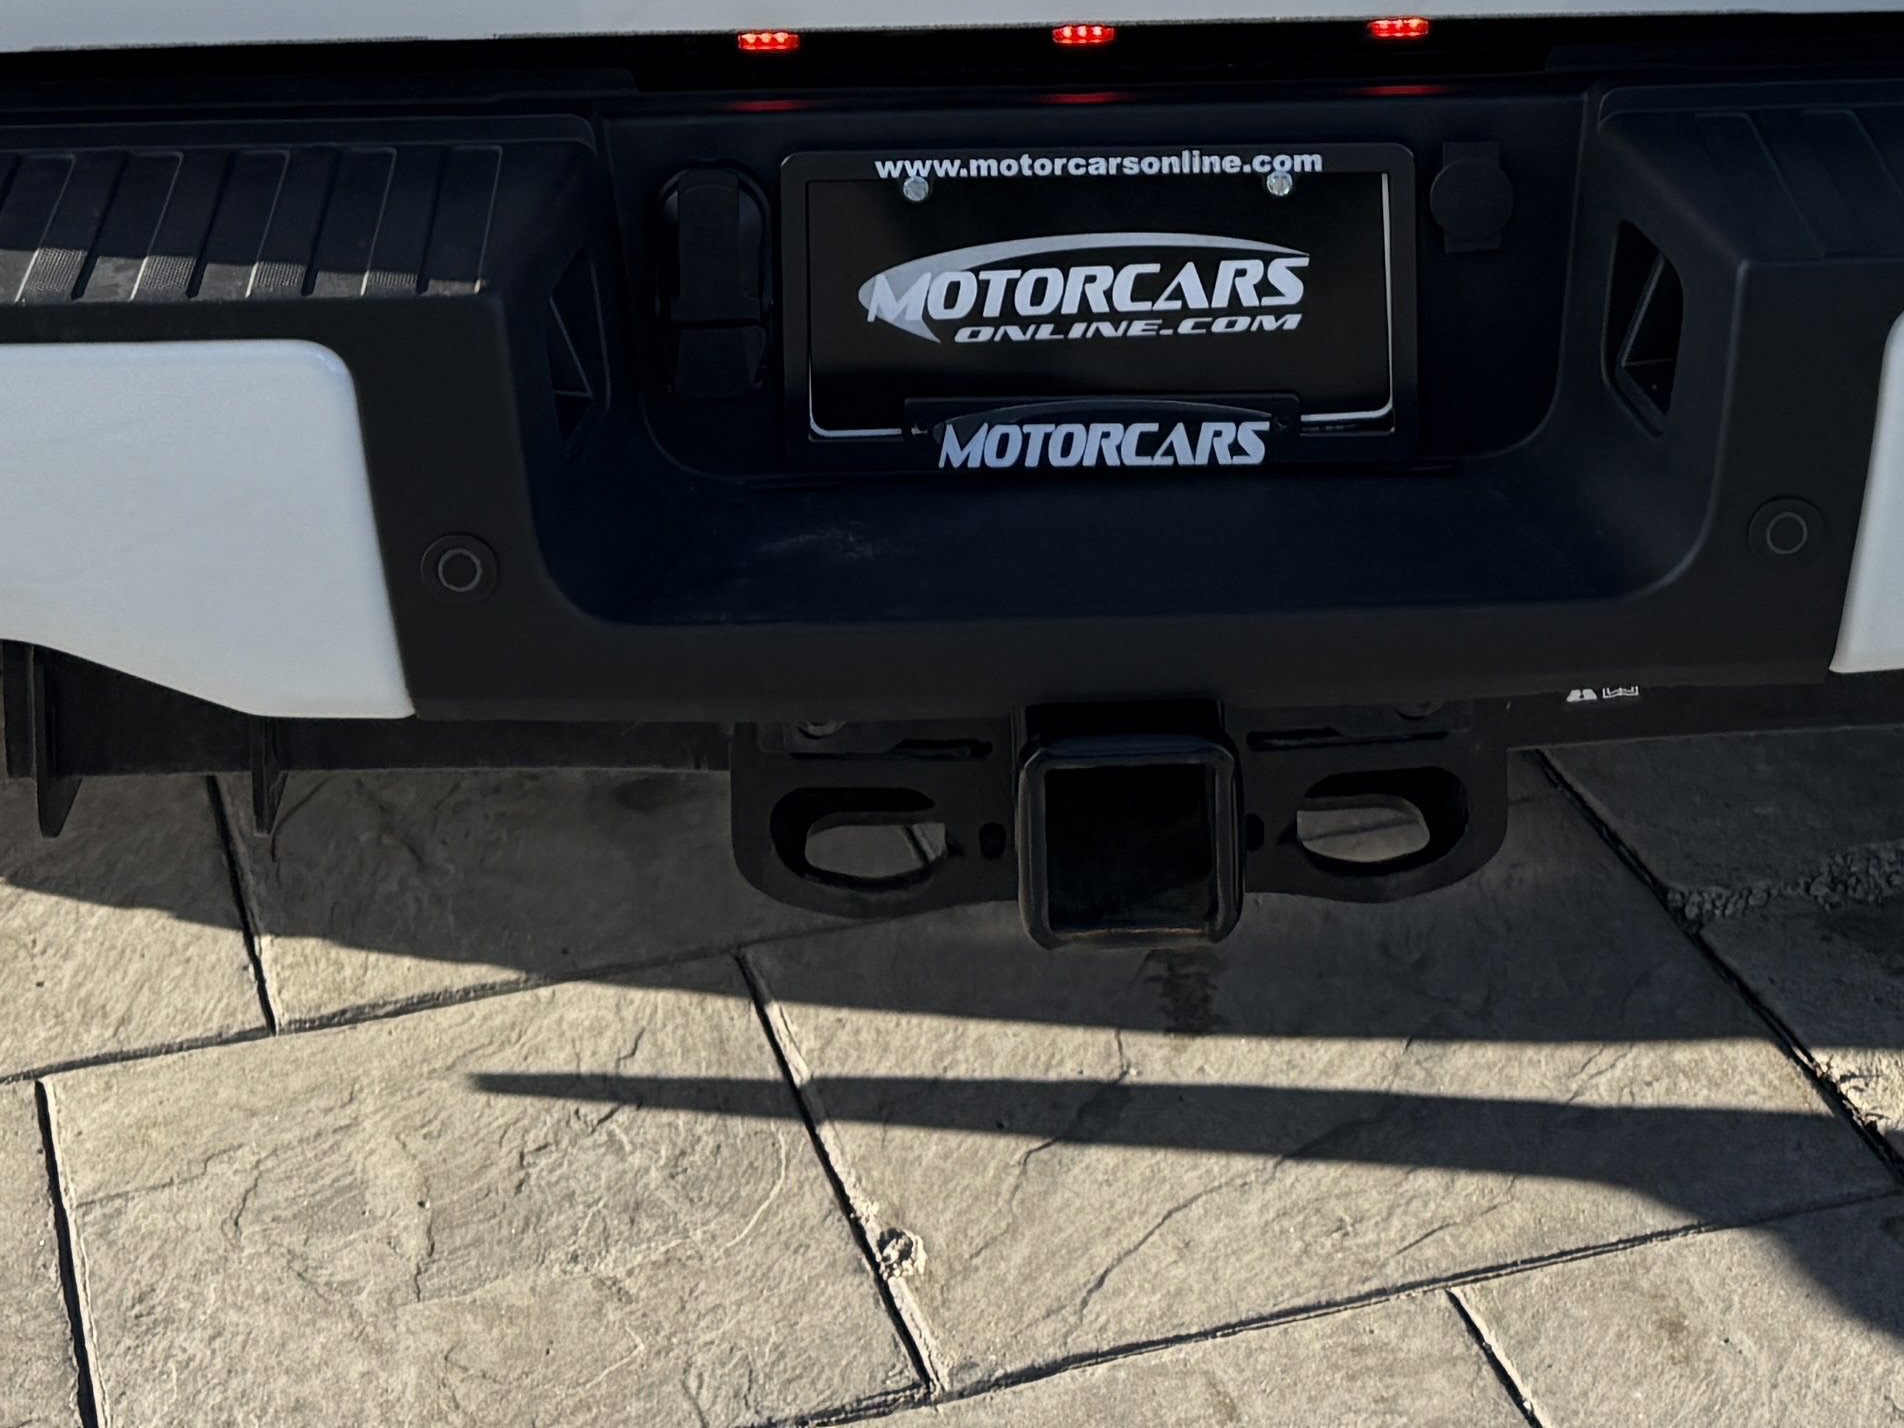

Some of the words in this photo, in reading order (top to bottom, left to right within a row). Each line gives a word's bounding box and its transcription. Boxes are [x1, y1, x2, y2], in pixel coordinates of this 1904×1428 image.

[874, 149, 1324, 179] www.motorcarsonline.com
[866, 256, 1310, 323] MOTORCARS
[954, 313, 1303, 343] ONLINE.COM
[938, 420, 1270, 469] MOTORCARS
